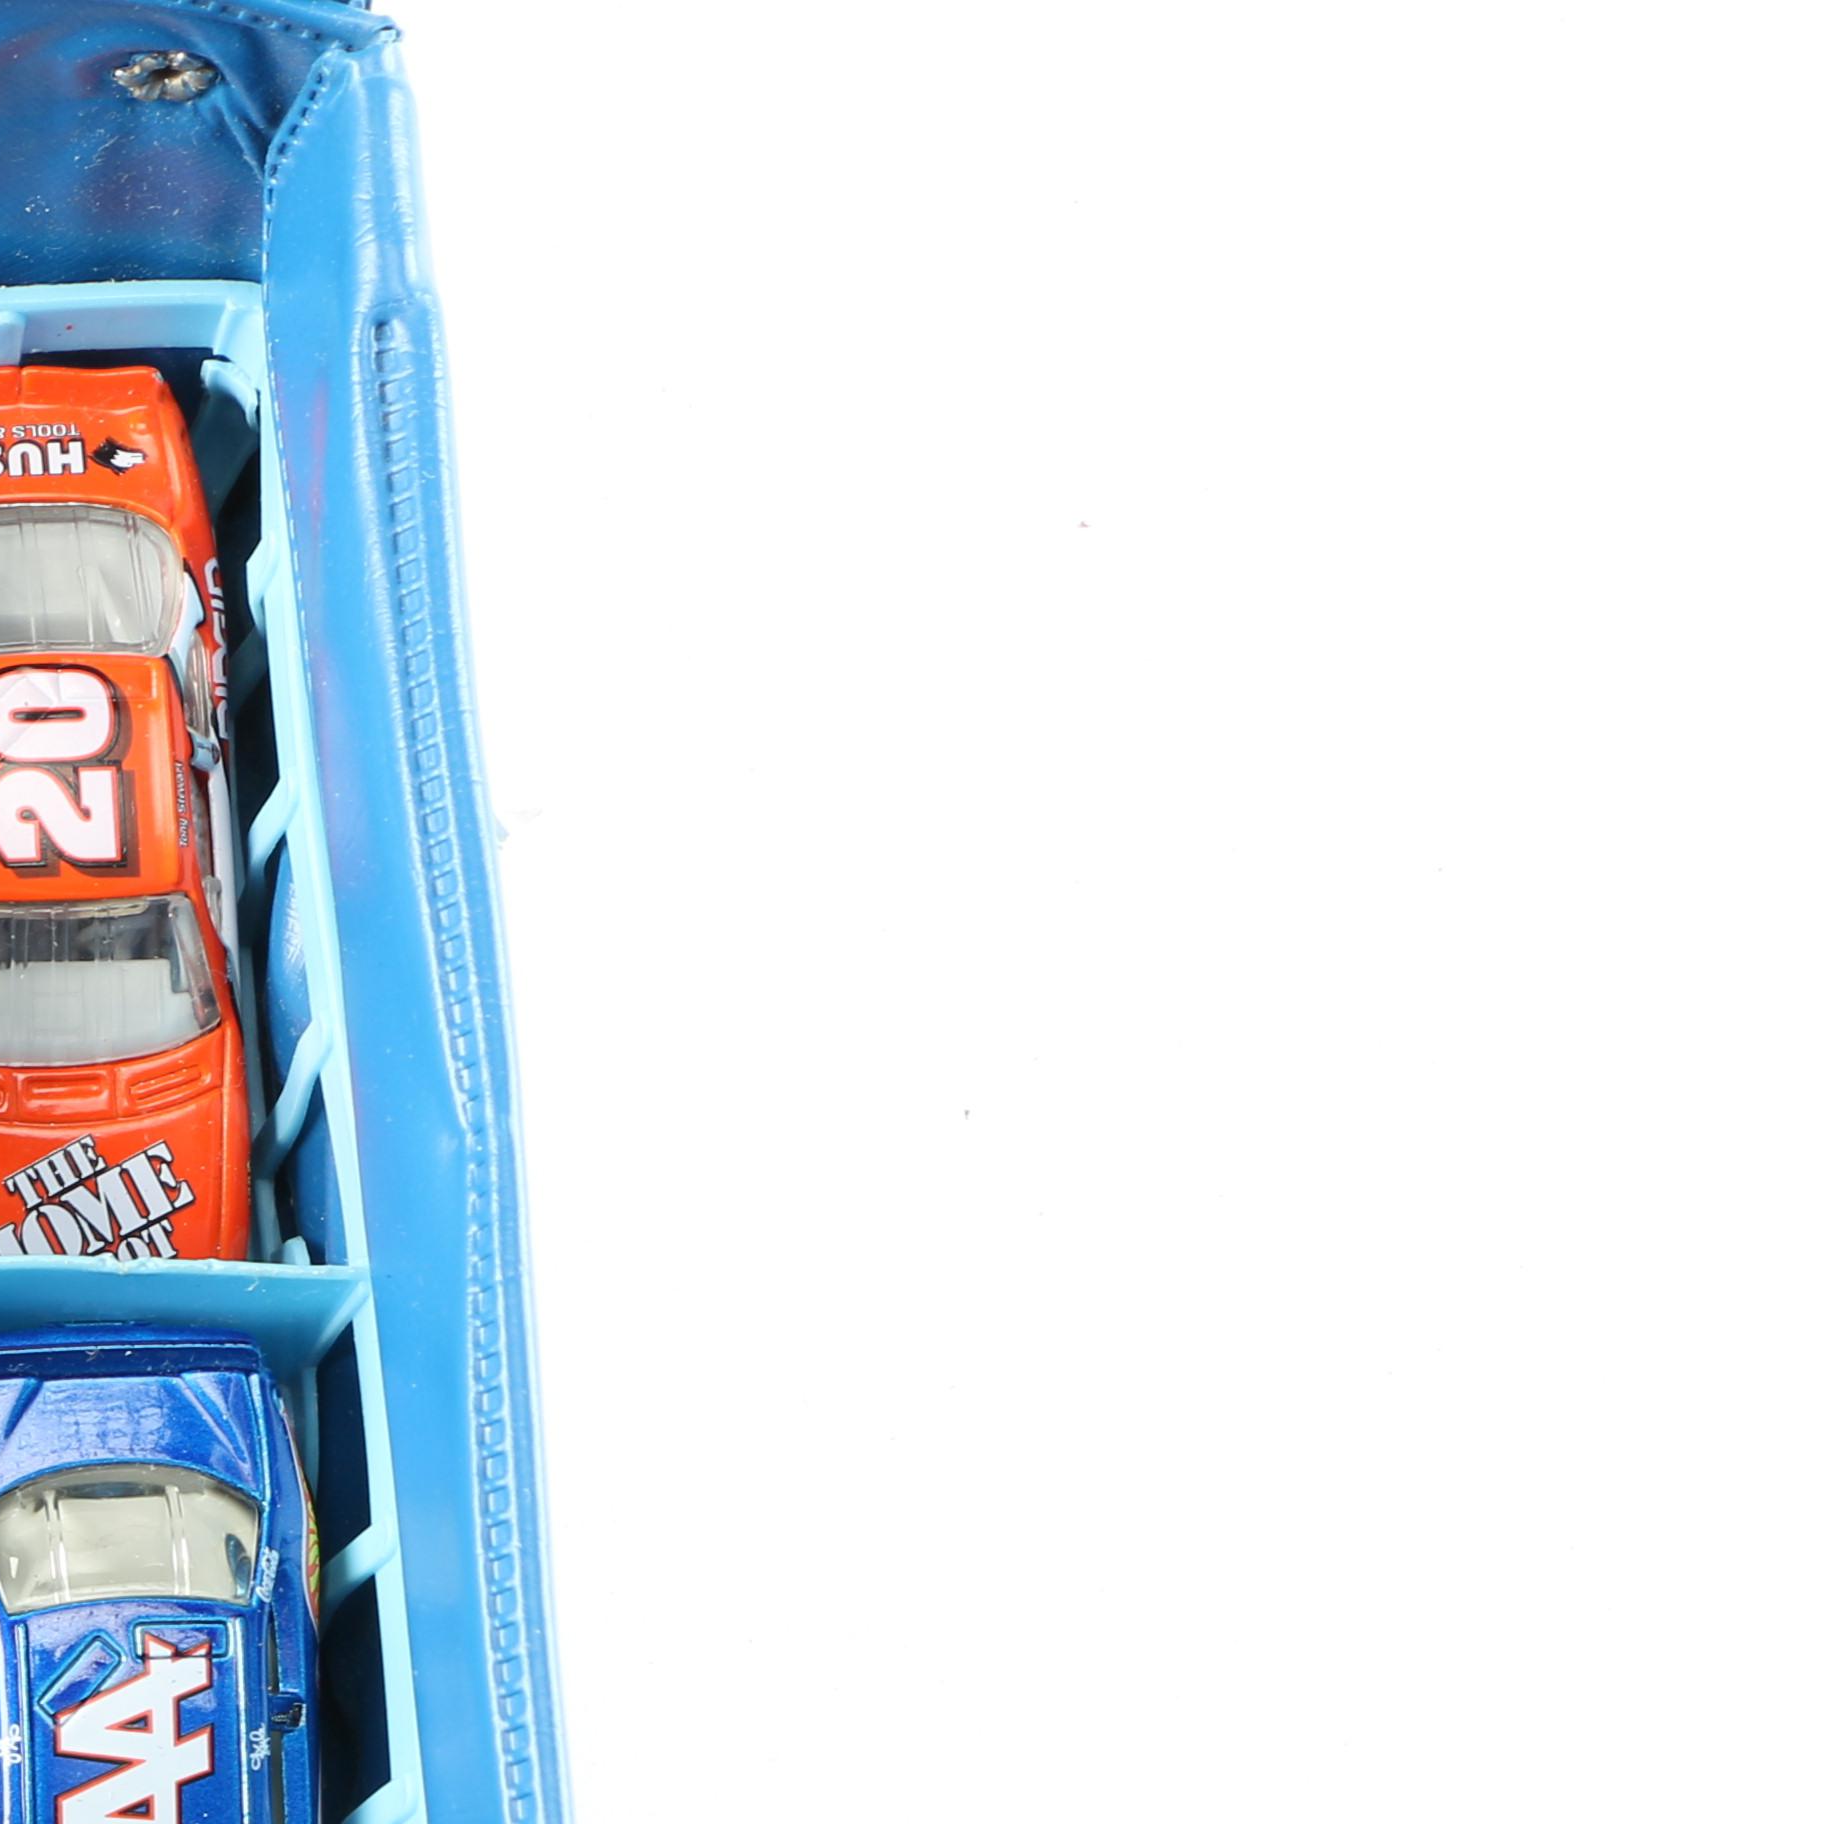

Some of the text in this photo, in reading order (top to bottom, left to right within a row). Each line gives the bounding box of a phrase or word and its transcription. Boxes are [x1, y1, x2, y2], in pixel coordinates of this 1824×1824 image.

[12, 424, 81, 440] TOOLS
[174, 761, 190, 848] Tony Stewart
[5, 1134, 107, 1209] THE
